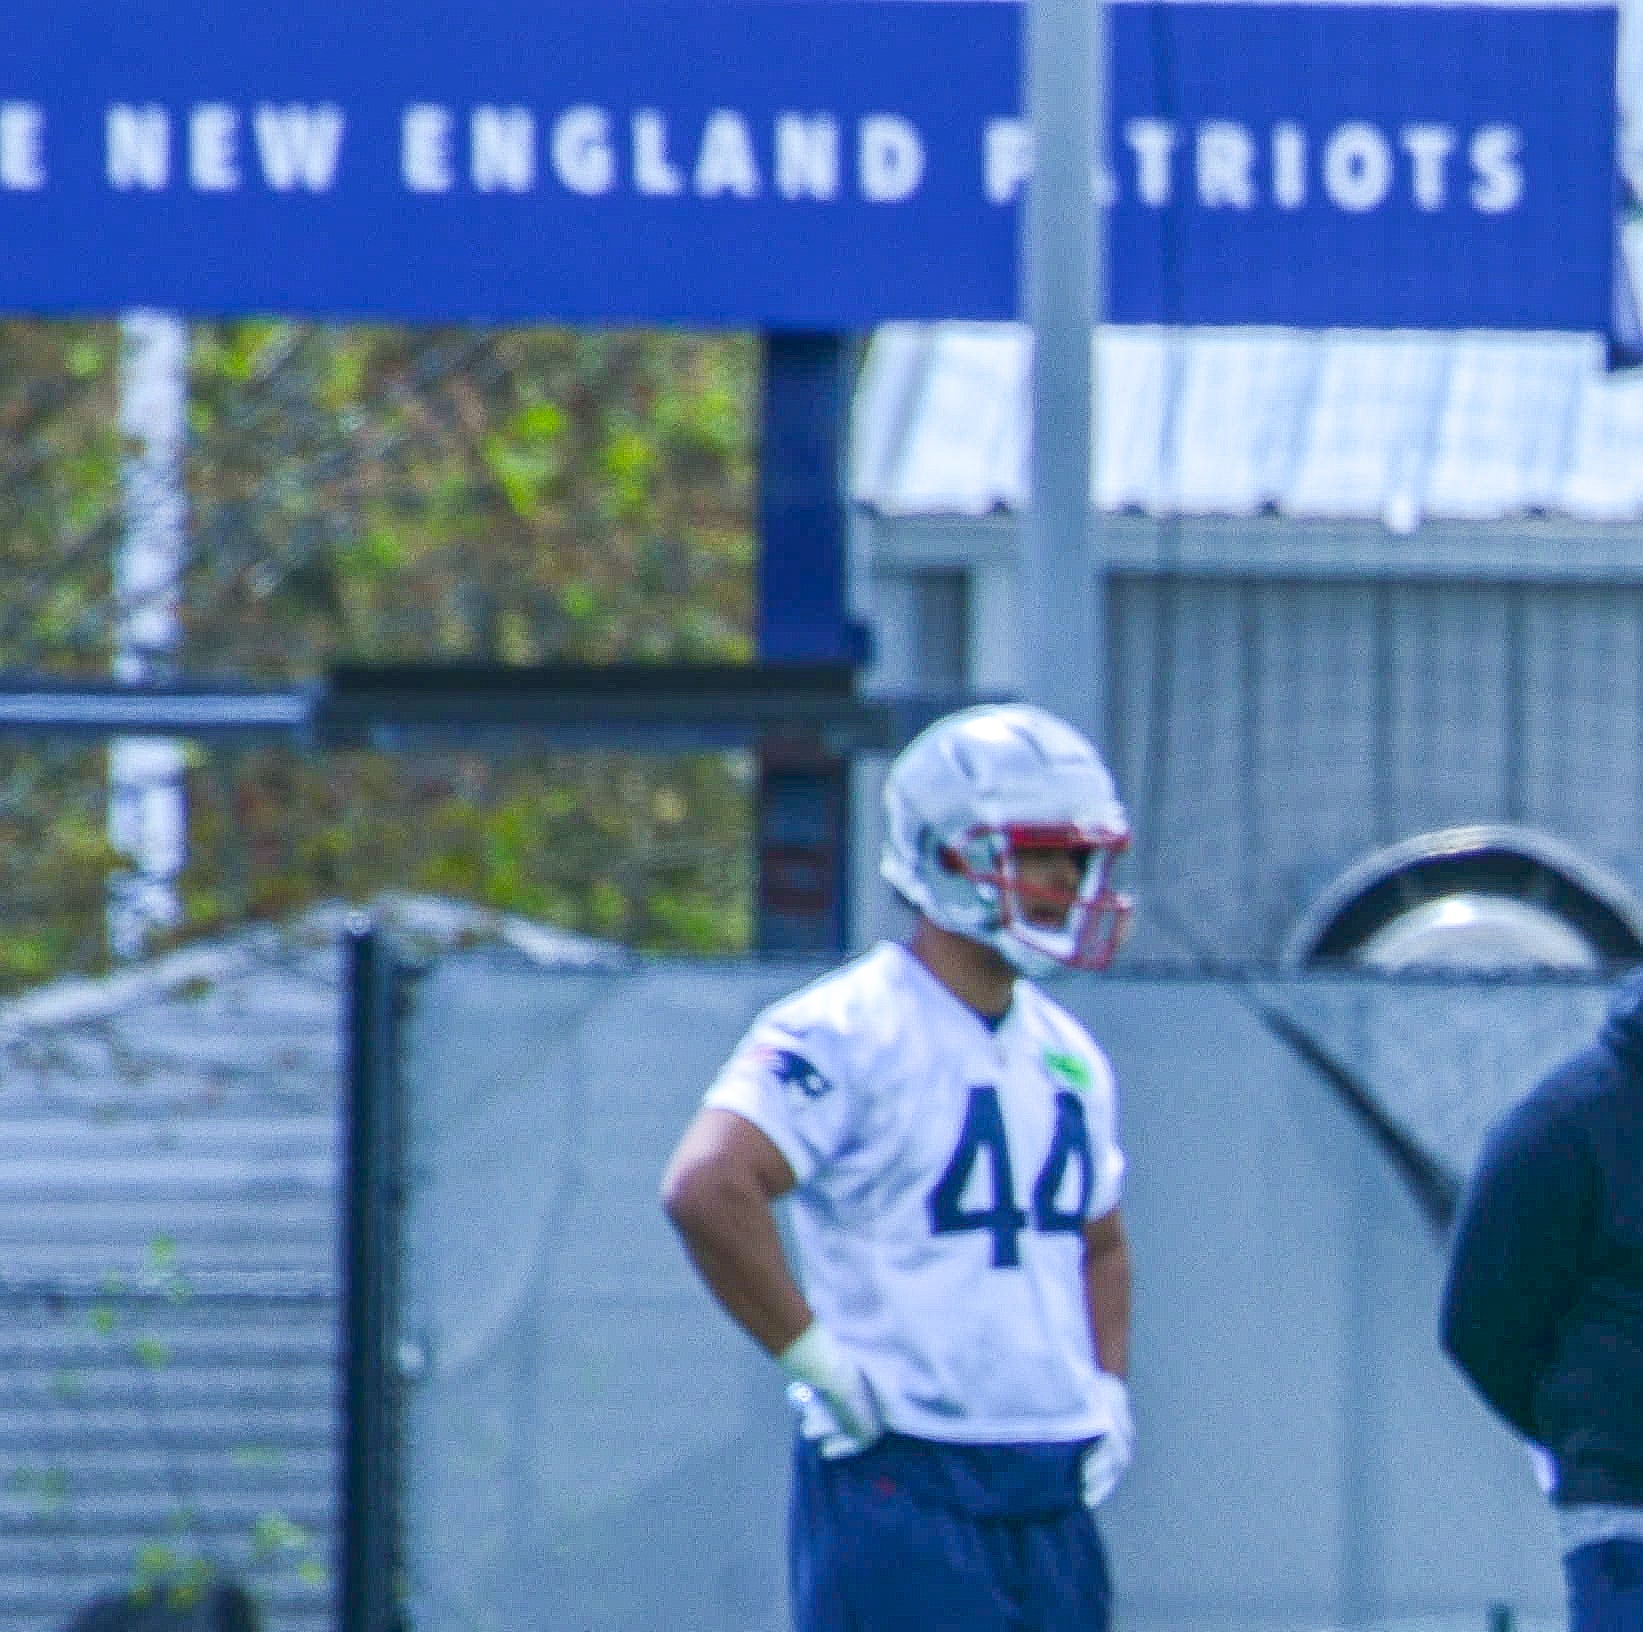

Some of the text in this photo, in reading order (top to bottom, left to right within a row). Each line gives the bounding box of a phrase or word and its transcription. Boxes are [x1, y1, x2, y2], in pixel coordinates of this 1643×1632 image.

[103, 101, 346, 195] NEW
[401, 103, 926, 203] ENGLAND
[984, 116, 1525, 213] PTRIOTS
[927, 1085, 1095, 1272] 44
